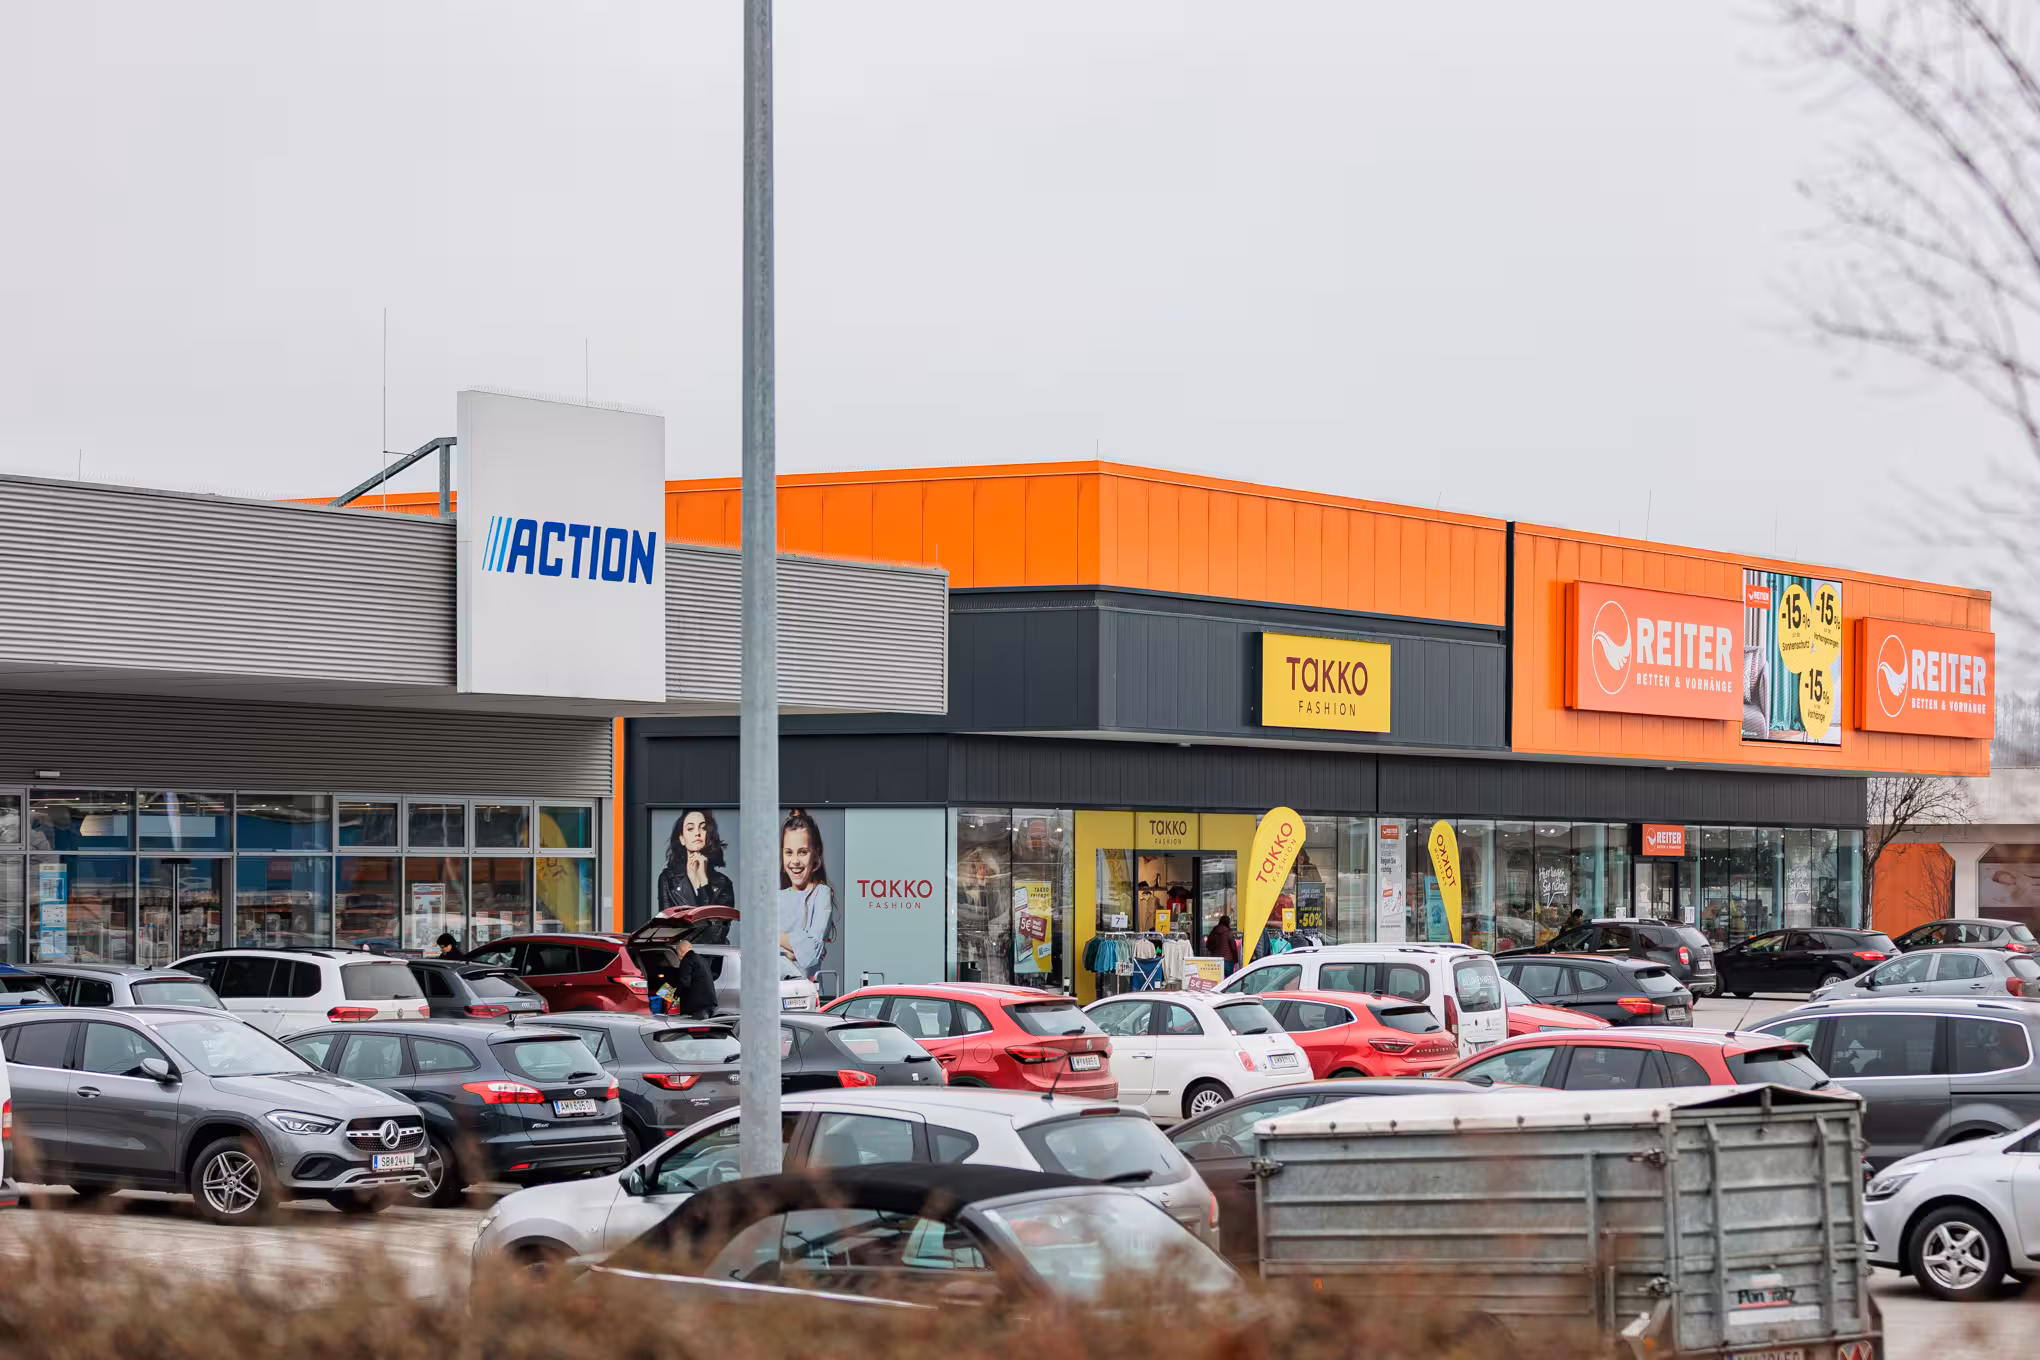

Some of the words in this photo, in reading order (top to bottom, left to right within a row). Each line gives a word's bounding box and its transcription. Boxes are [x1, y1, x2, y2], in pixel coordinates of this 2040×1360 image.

[506, 518, 656, 585] ACTION
[1636, 617, 1733, 672] REITER
[1911, 648, 1986, 696] REITER
[1636, 672, 1670, 687] BETTEN
[1674, 676, 1681, 688] &
[1685, 676, 1733, 692] VORHÄNGE
[1298, 700, 1356, 716] FASHION
[1911, 697, 1938, 710] BETTEN
[1941, 699, 1947, 710] &
[1949, 699, 1986, 714] VORHÄNGE
[1656, 831, 1682, 844] REITER
[1272, 839, 1297, 882] FASHION
[1020, 917, 1032, 932] 5€
[1300, 912, 1322, 927] -50%
